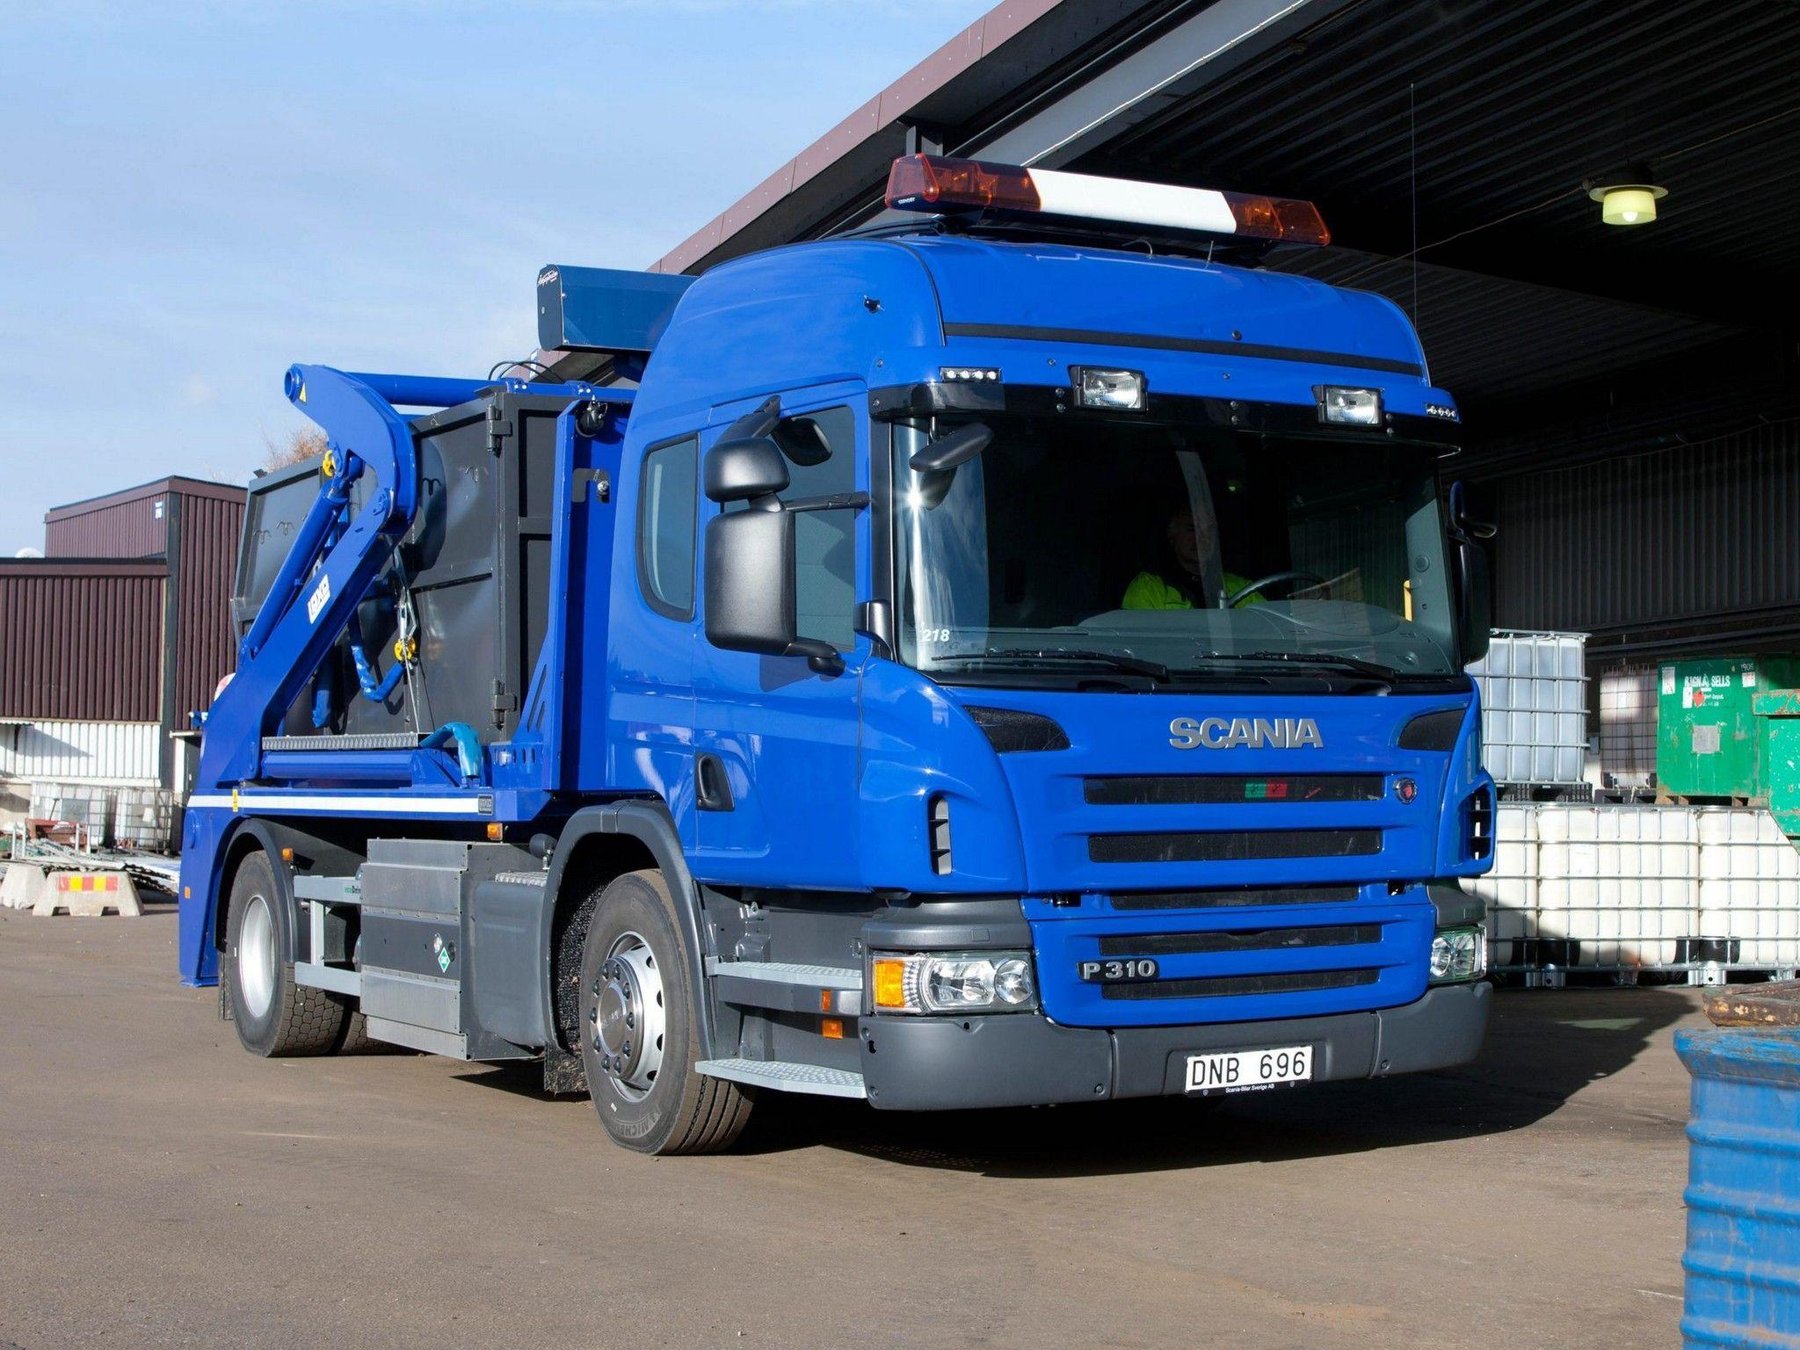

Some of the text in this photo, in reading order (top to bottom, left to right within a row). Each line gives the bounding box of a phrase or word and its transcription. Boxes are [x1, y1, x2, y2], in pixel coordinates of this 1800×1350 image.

[922, 628, 950, 642] 218
[1711, 675, 1731, 687] SELLS
[1169, 717, 1324, 749] SCANIA
[1083, 959, 1156, 980] P 310
[1191, 1051, 1306, 1086] DNB 696
